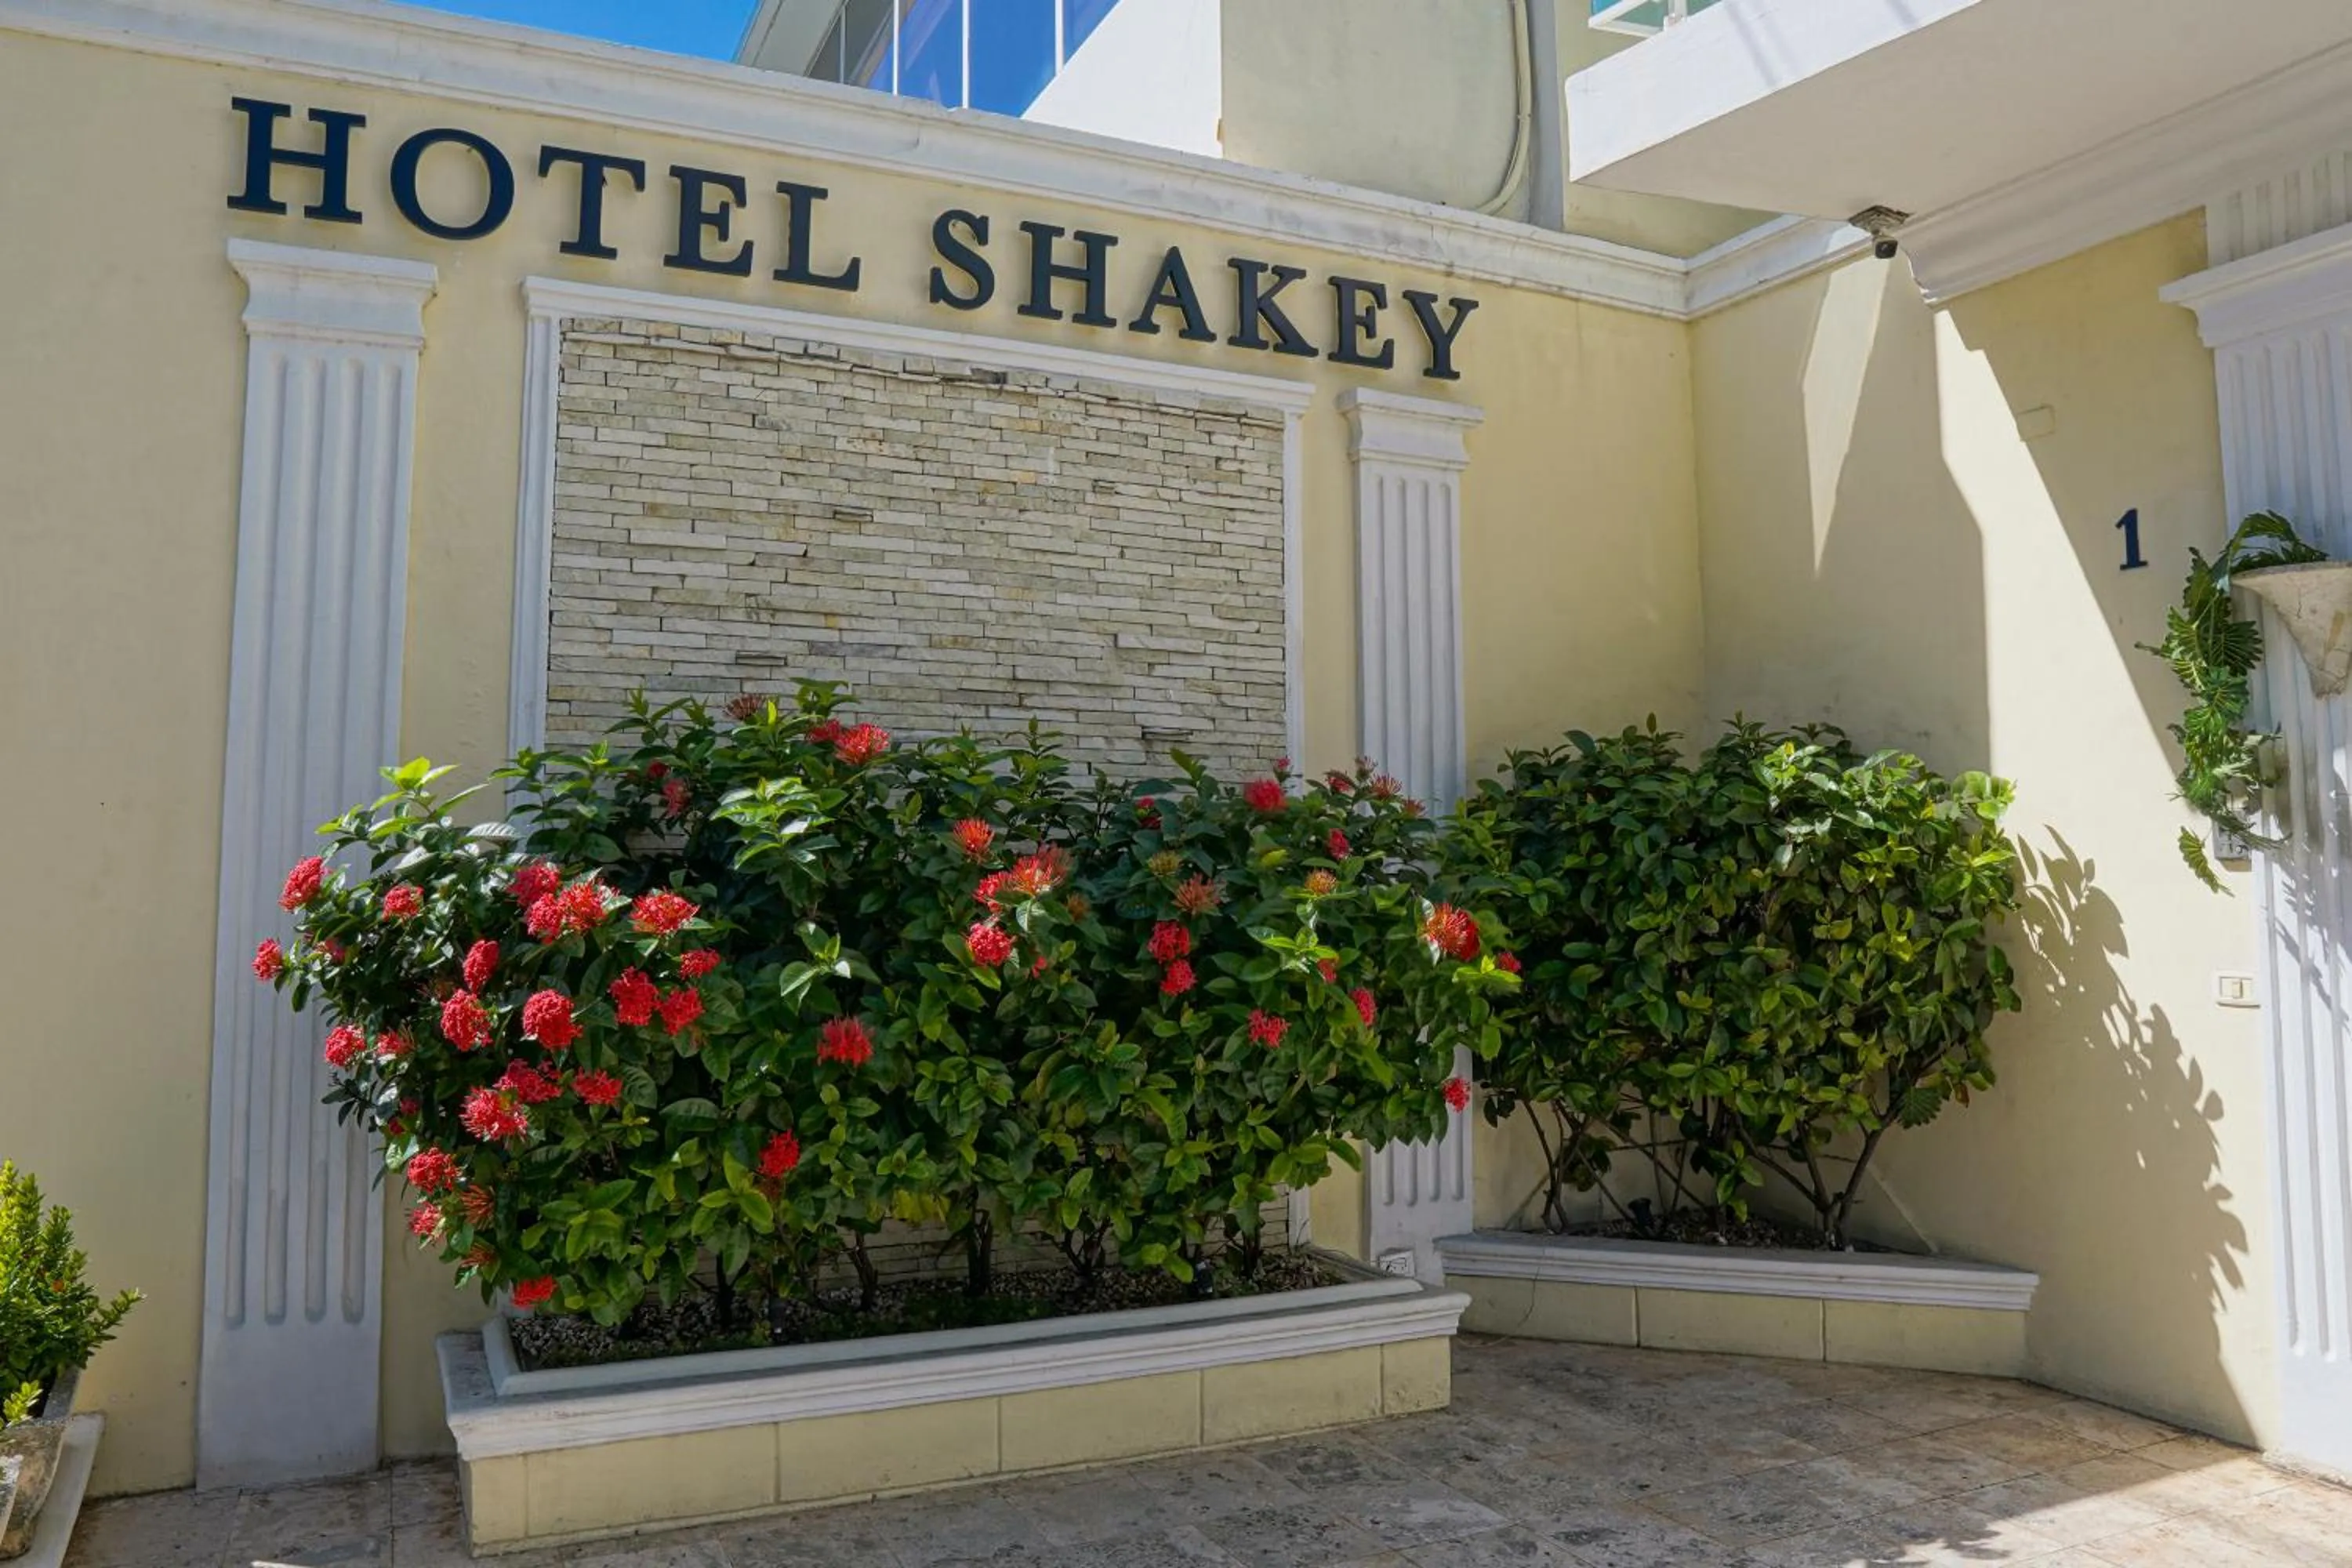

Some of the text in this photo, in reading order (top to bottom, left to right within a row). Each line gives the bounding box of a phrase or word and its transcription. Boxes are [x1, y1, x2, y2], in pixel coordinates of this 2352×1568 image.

[227, 96, 1479, 381] HOTEL SHAKEY
[2115, 508, 2148, 571] 1
